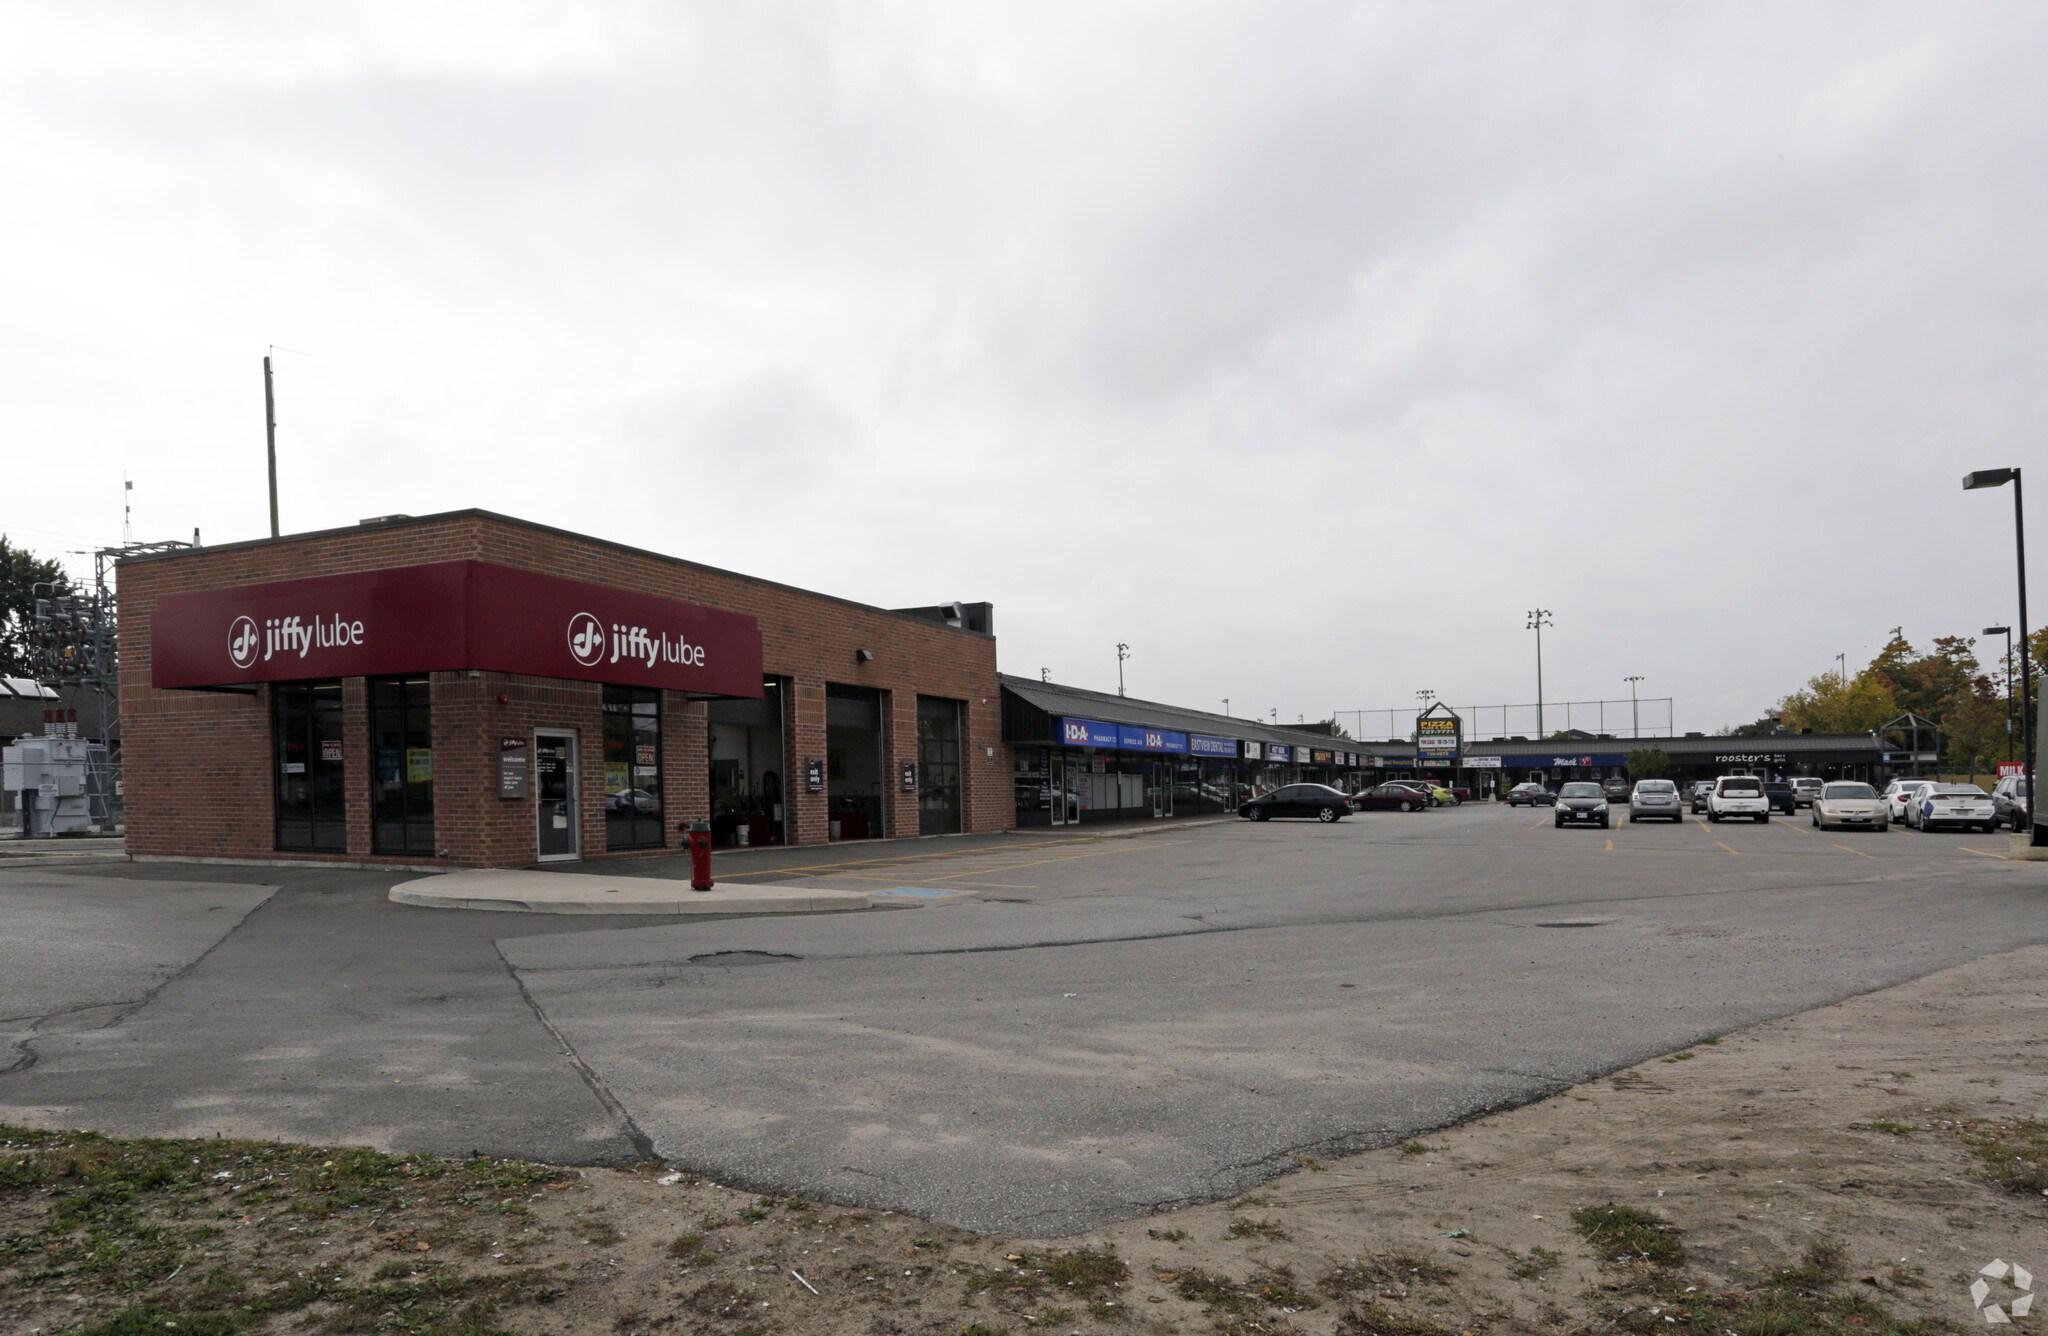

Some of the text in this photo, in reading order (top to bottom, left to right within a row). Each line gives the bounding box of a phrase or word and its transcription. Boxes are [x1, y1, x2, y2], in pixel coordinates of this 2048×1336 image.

[264, 613, 364, 661] jiffy lube
[610, 623, 705, 668] jiffy lube
[1210, 740, 1224, 753] DENTAL
[323, 748, 340, 758] OPEN
[638, 753, 654, 762] OPEN
[1715, 754, 1771, 763] rooster's
[2000, 765, 2024, 776] MILK
